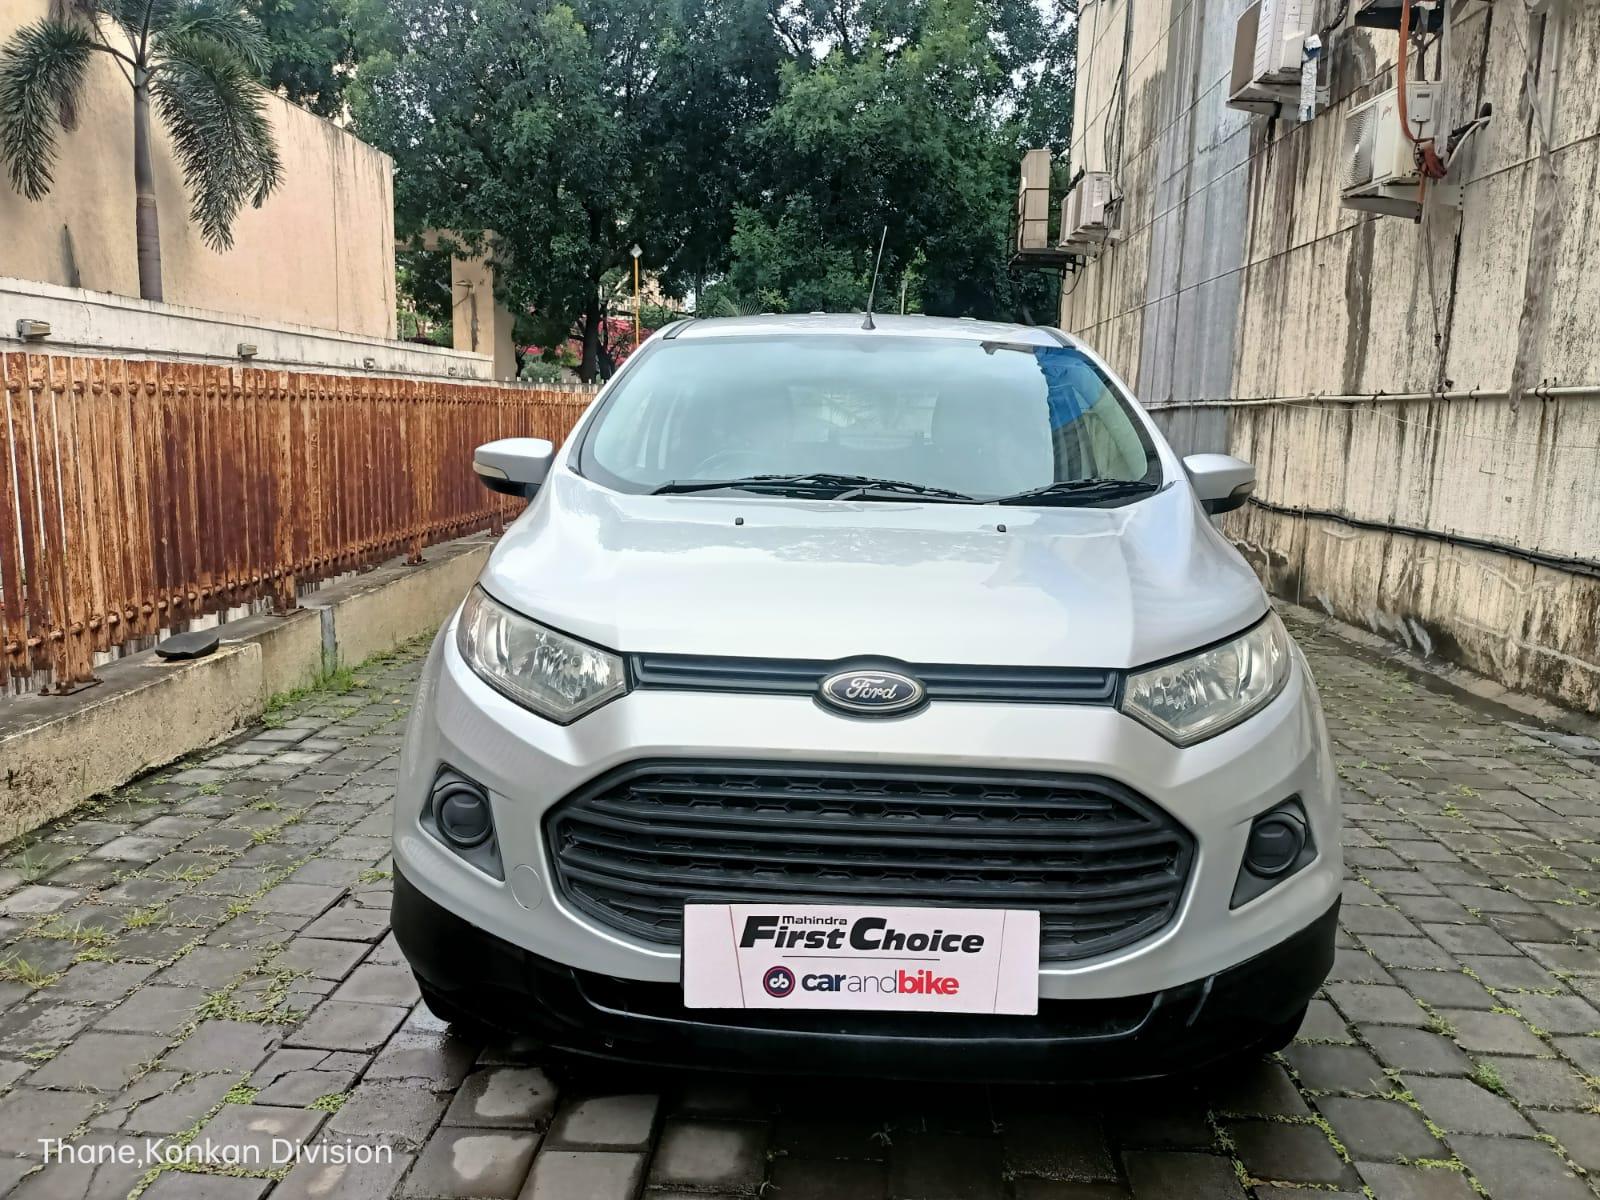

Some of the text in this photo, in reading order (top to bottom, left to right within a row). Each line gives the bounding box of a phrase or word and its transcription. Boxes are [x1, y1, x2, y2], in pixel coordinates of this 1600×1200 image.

[845, 677, 898, 699] Ford
[781, 915, 847, 926] Mahindra
[739, 915, 985, 954] First Choice
[801, 969, 960, 996] carandbike
